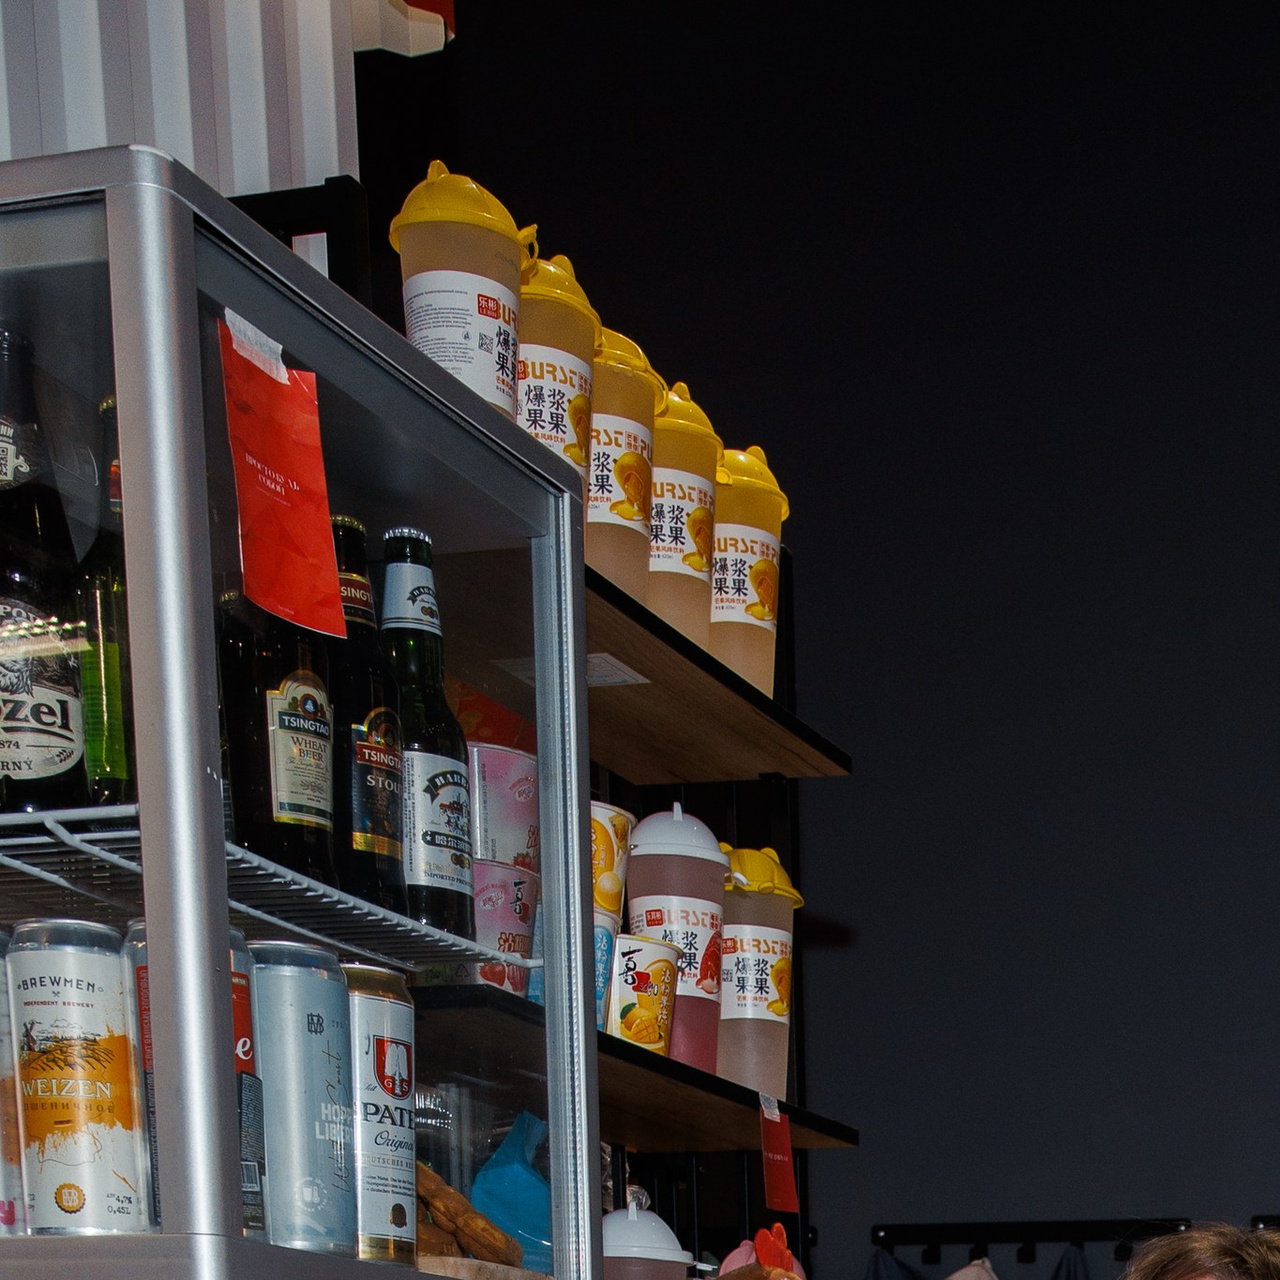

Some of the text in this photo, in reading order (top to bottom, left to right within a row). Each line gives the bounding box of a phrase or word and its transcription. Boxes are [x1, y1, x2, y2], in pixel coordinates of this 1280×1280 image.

[526, 384, 568, 415] 爆浆
[525, 409, 568, 435] 果果
[650, 525, 686, 546] 果果
[712, 557, 748, 578] 爆浆
[713, 577, 748, 597] 果果
[282, 715, 330, 738] TSINGTAO
[291, 736, 328, 754] WHEAT
[298, 748, 325, 764] BEER
[424, 871, 456, 886] IMPORTED
[20, 975, 96, 995] BREWMEN
[735, 976, 771, 996] 果果
[62, 1000, 95, 1009] BREWERY
[736, 994, 769, 1002] 芒果味饮料
[20, 1078, 112, 1100] WEIZEN
[384, 1077, 409, 1093] G S
[24, 1101, 116, 1114] ПШЕНИЧНОЕ
[358, 1100, 416, 1131] PATE
